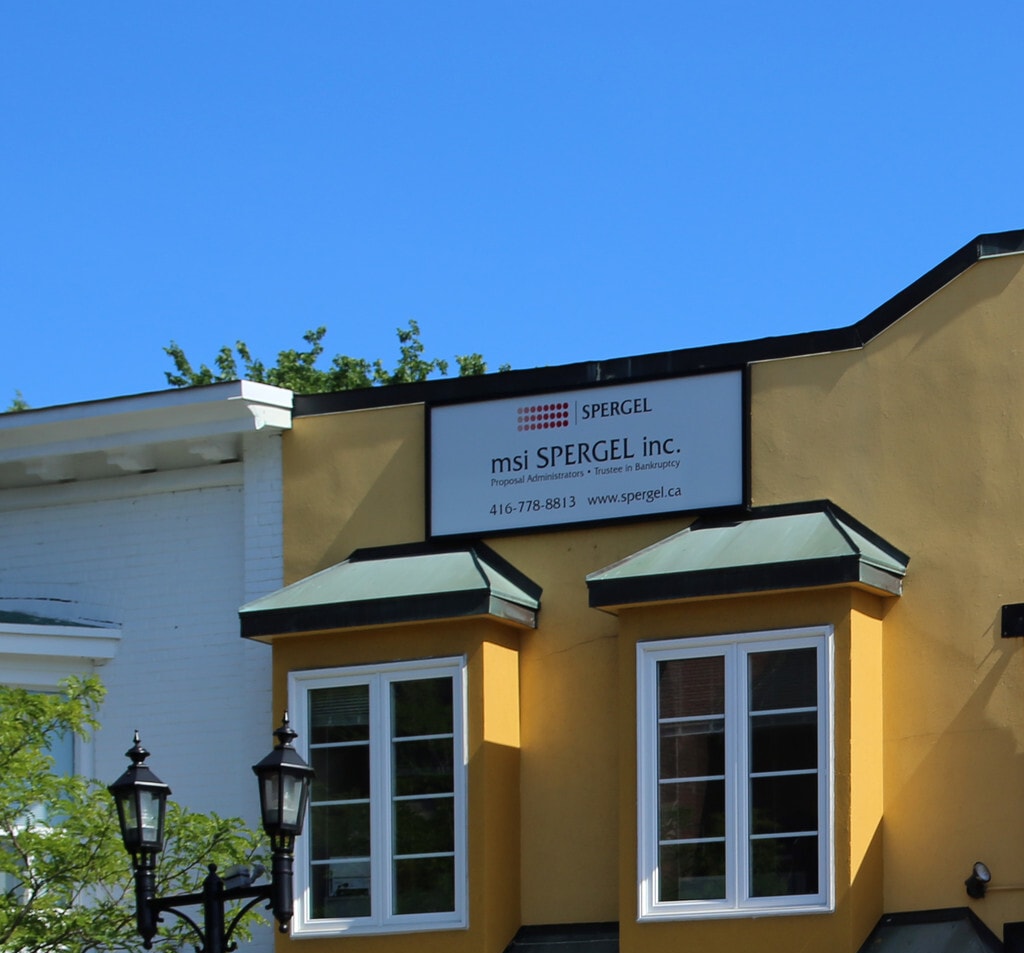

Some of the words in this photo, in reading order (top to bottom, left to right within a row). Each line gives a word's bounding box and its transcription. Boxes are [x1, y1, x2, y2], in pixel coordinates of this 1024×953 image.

[581, 397, 653, 421] SPERGEL
[491, 450, 529, 474] msi
[536, 437, 635, 470] SPERGEL
[642, 436, 682, 458] inc.
[490, 476, 526, 488] Proposal
[526, 469, 585, 484] Administrators
[594, 465, 623, 476] Trustee
[624, 463, 634, 473] in
[634, 459, 681, 472] Bankruptcy
[489, 495, 577, 516] 416-778-8813
[587, 485, 682, 505] www.spergel.ca
